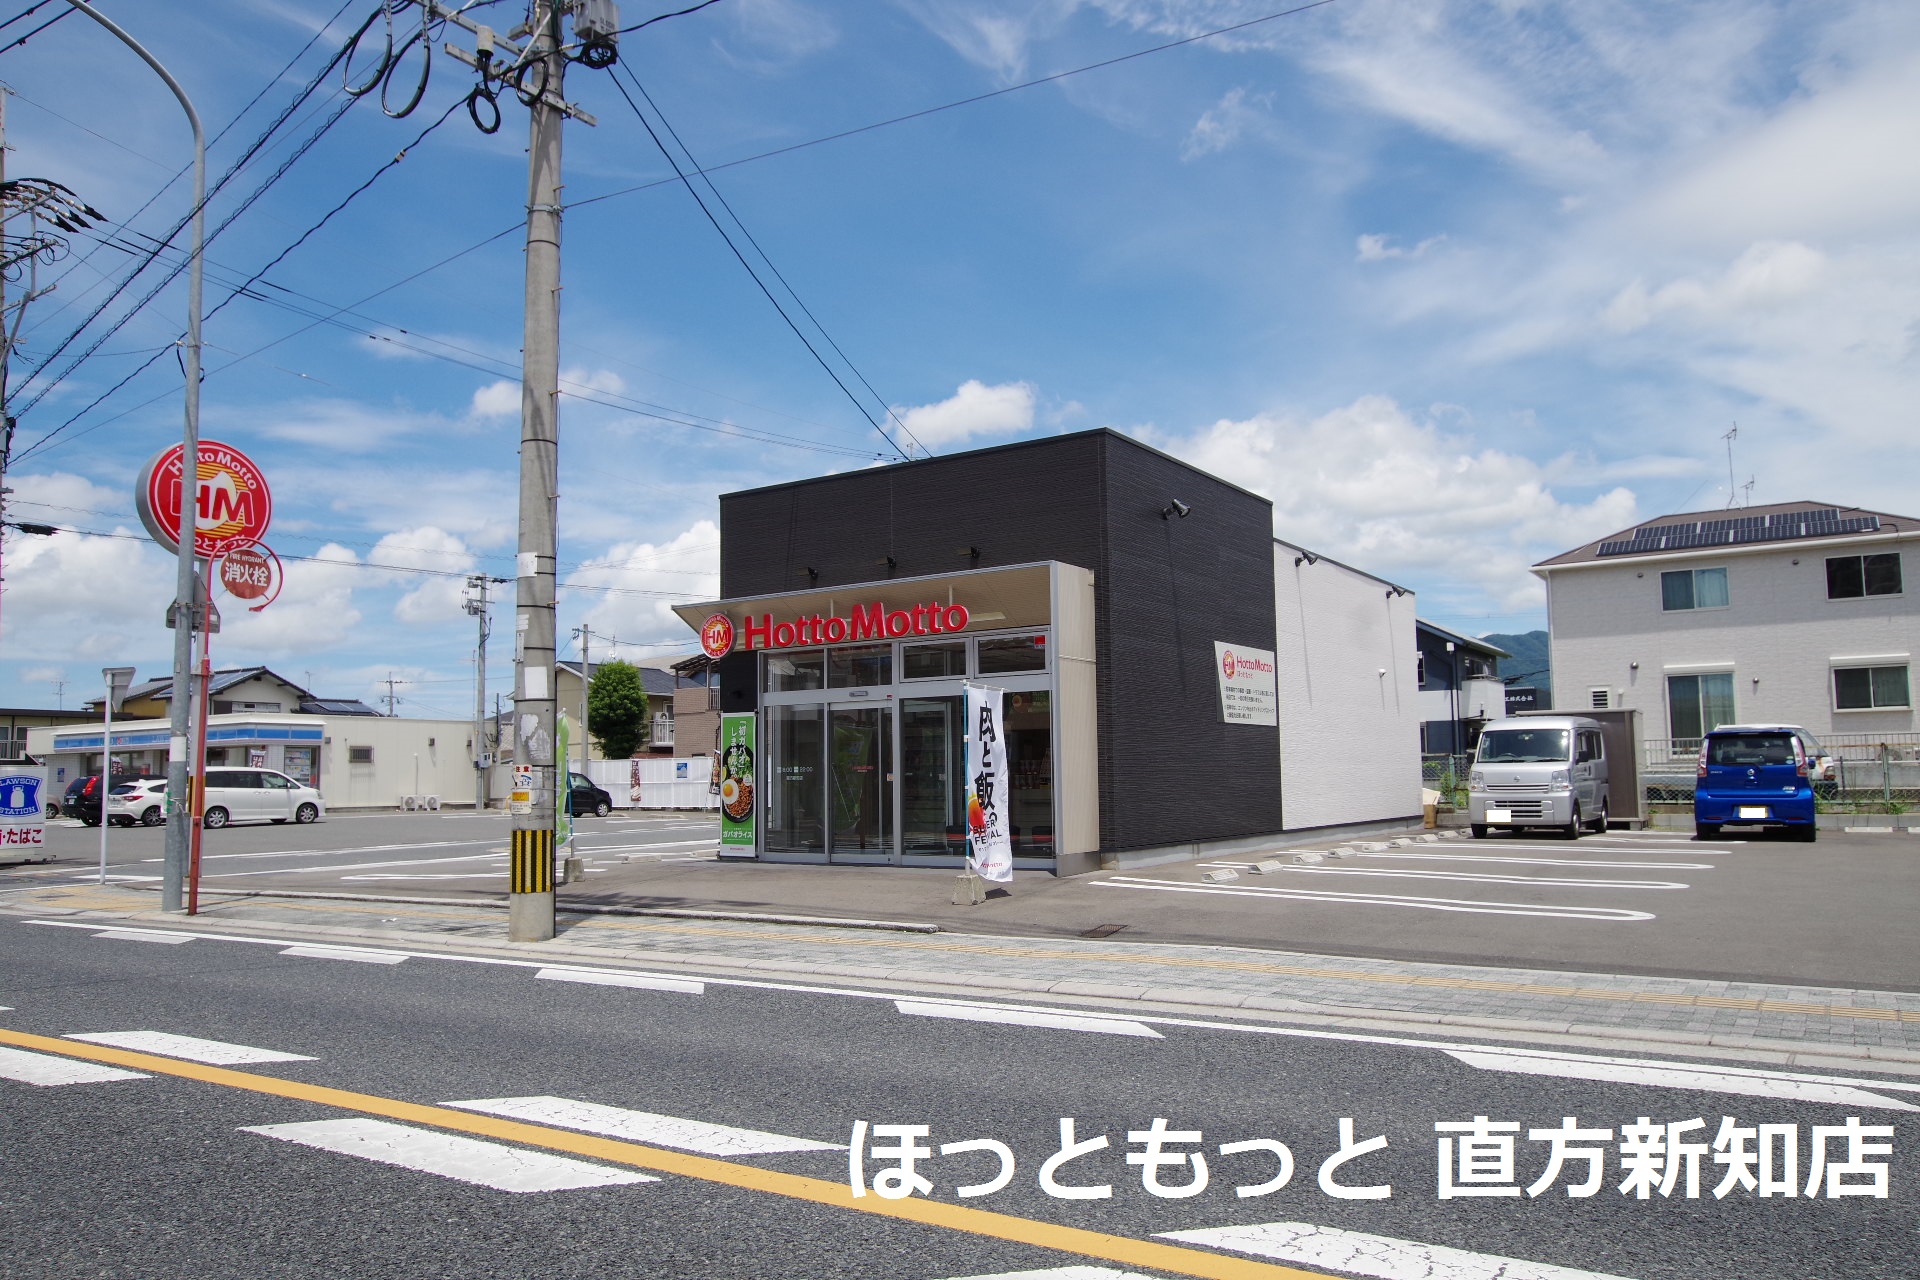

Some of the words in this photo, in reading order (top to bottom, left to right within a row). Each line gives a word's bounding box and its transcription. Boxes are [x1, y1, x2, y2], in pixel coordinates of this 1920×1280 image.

[168, 451, 214, 475] Hto
[216, 451, 257, 490] Motto
[229, 553, 241, 561] FIRE
[241, 555, 265, 565] HYDRANT
[225, 561, 268, 586] 消火栓
